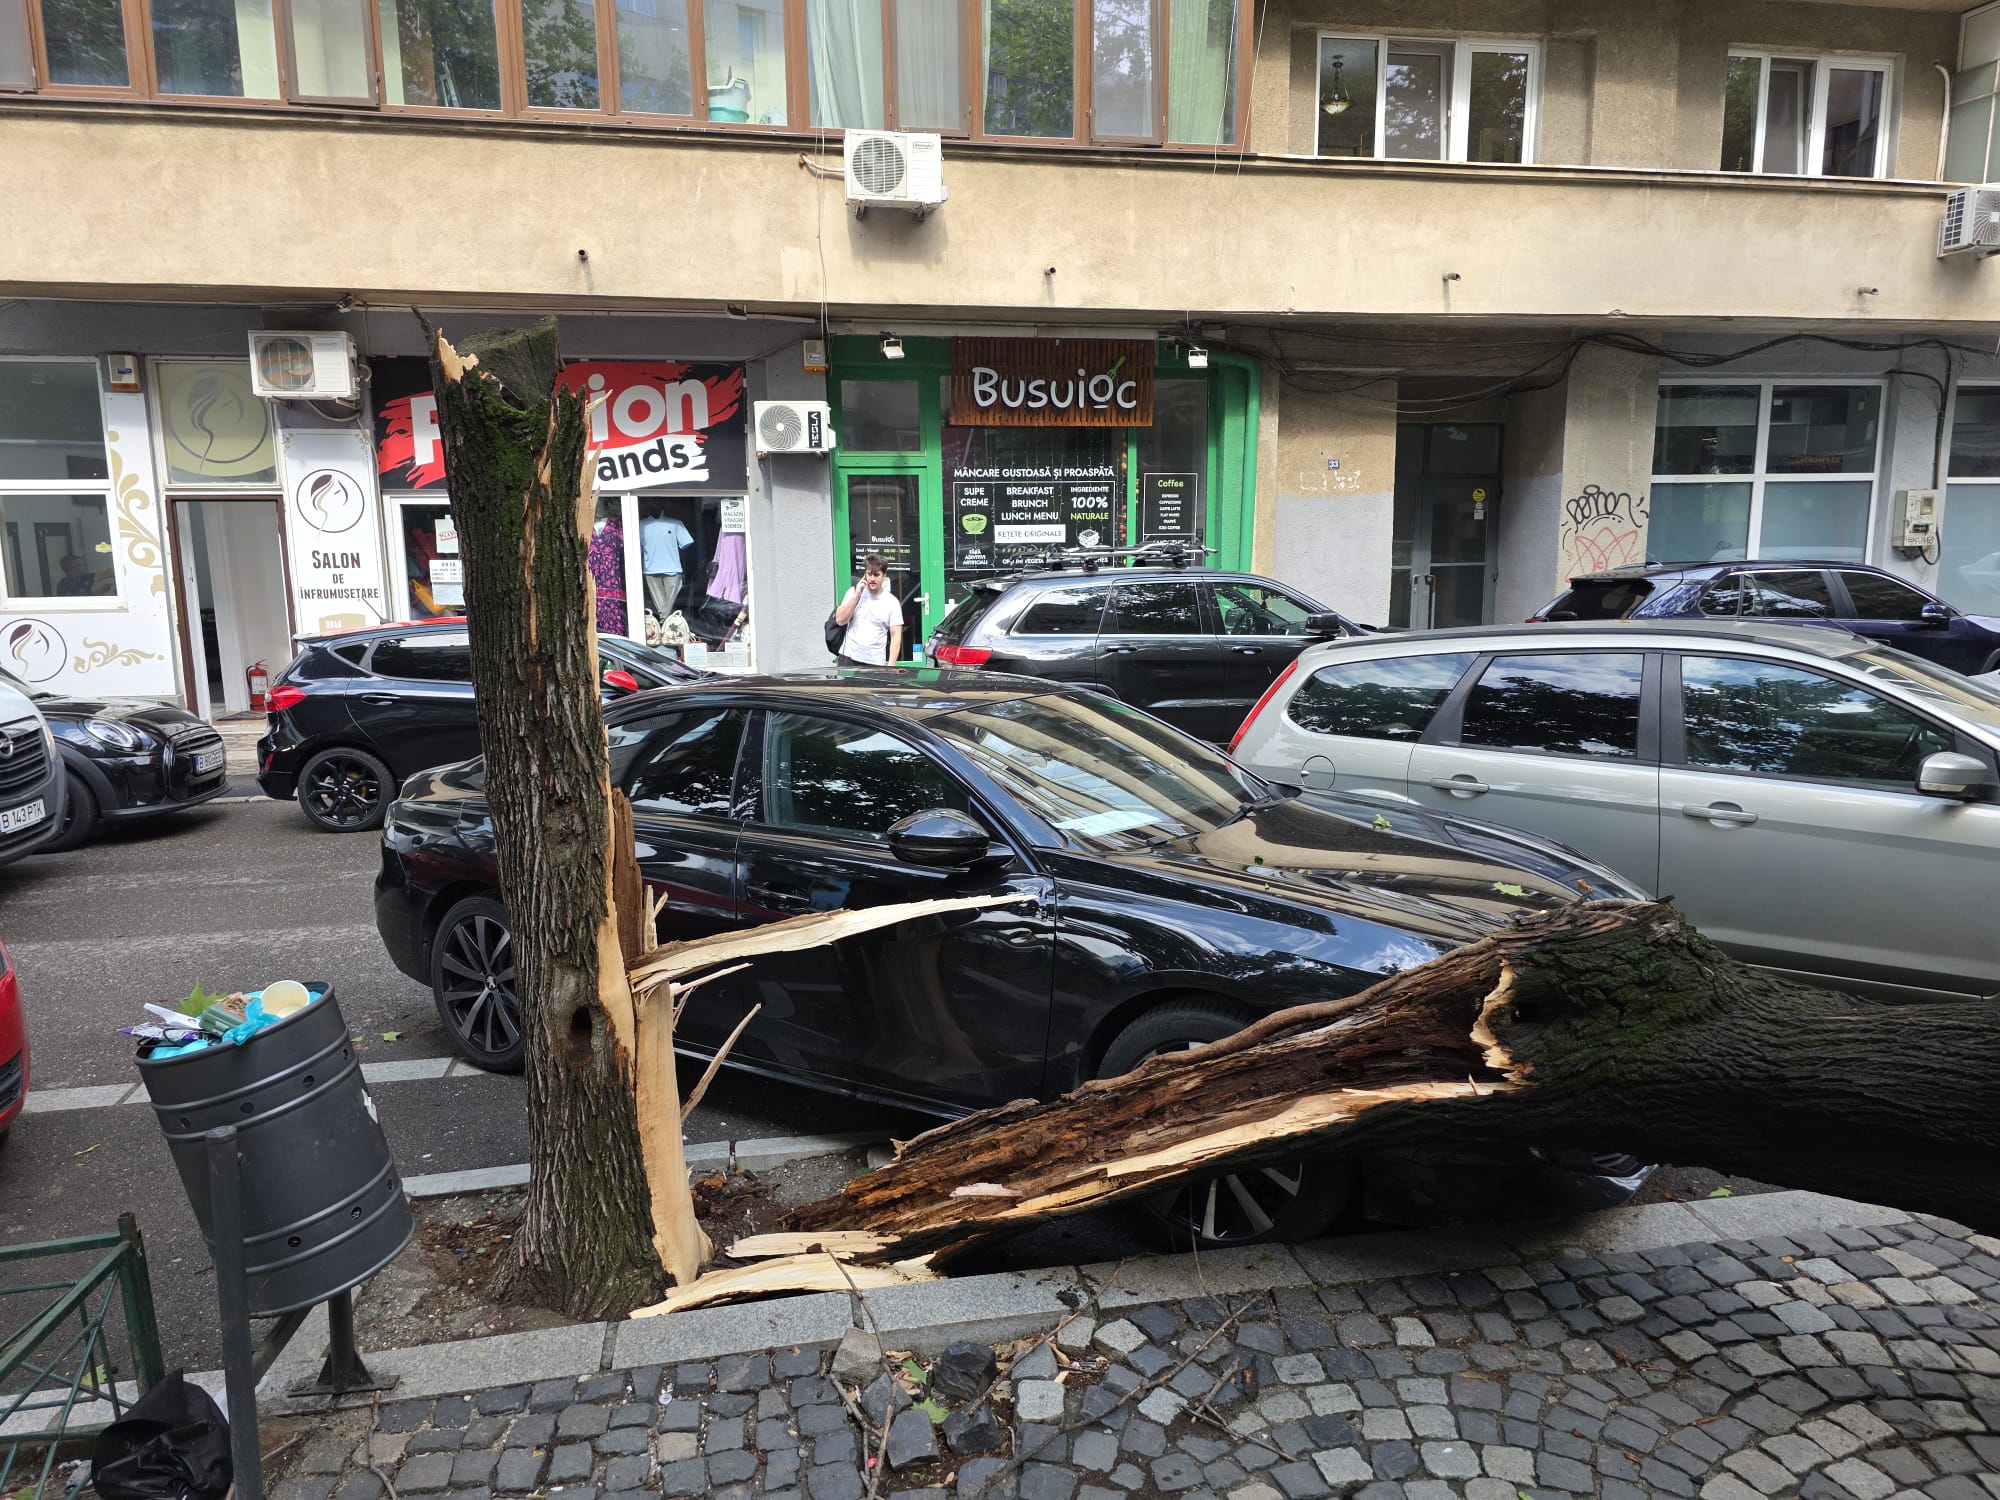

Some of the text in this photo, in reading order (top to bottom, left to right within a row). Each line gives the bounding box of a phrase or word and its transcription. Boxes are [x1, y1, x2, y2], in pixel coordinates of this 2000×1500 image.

[972, 366, 1137, 408] Busuioc
[954, 466, 1000, 478] MÂNCARE
[1002, 466, 1051, 478] GUSTOASĂ
[1064, 465, 1115, 477] PROASPĂTĂ
[1157, 479, 1184, 488] Coffee
[964, 487, 985, 496] SUPE
[1006, 486, 1054, 496] BREAKFAST
[960, 498, 989, 507] CREME
[1011, 499, 1048, 508] BRUNCH
[1071, 496, 1109, 509] 100%
[1001, 511, 1059, 520] LUNCH MENU
[1070, 512, 1109, 520] NATURALE
[1024, 530, 1063, 538] ORIGINALE
[312, 550, 361, 569] SALON
[332, 574, 345, 584] DE
